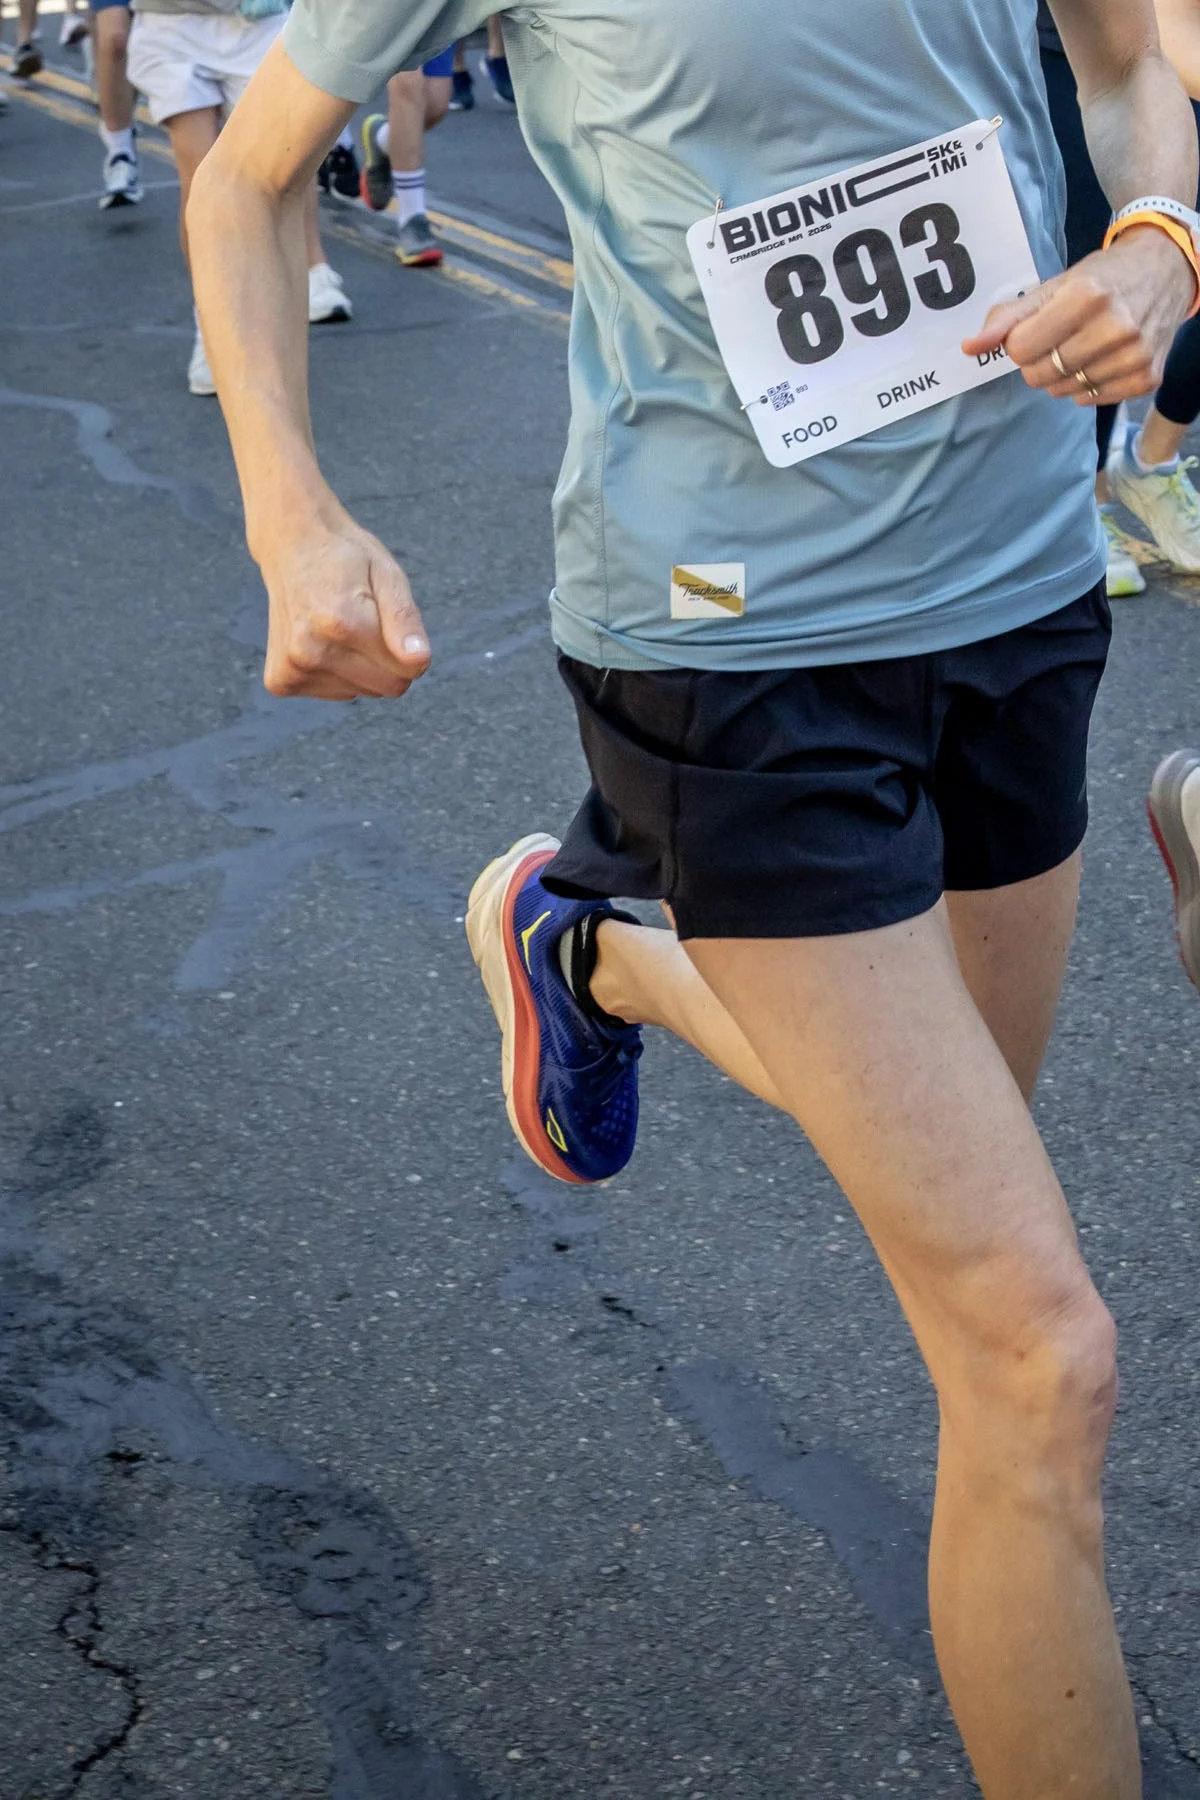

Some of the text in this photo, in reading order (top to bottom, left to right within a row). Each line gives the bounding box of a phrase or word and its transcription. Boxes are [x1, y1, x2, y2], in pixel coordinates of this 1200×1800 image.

[926, 140, 963, 162] 5K&
[719, 151, 931, 255] BIONIC
[730, 239, 785, 264] CAMBRIDGE
[764, 202, 976, 365] 893
[781, 370, 940, 448] FOOD DRINK
[679, 582, 738, 598] Tracksmith
